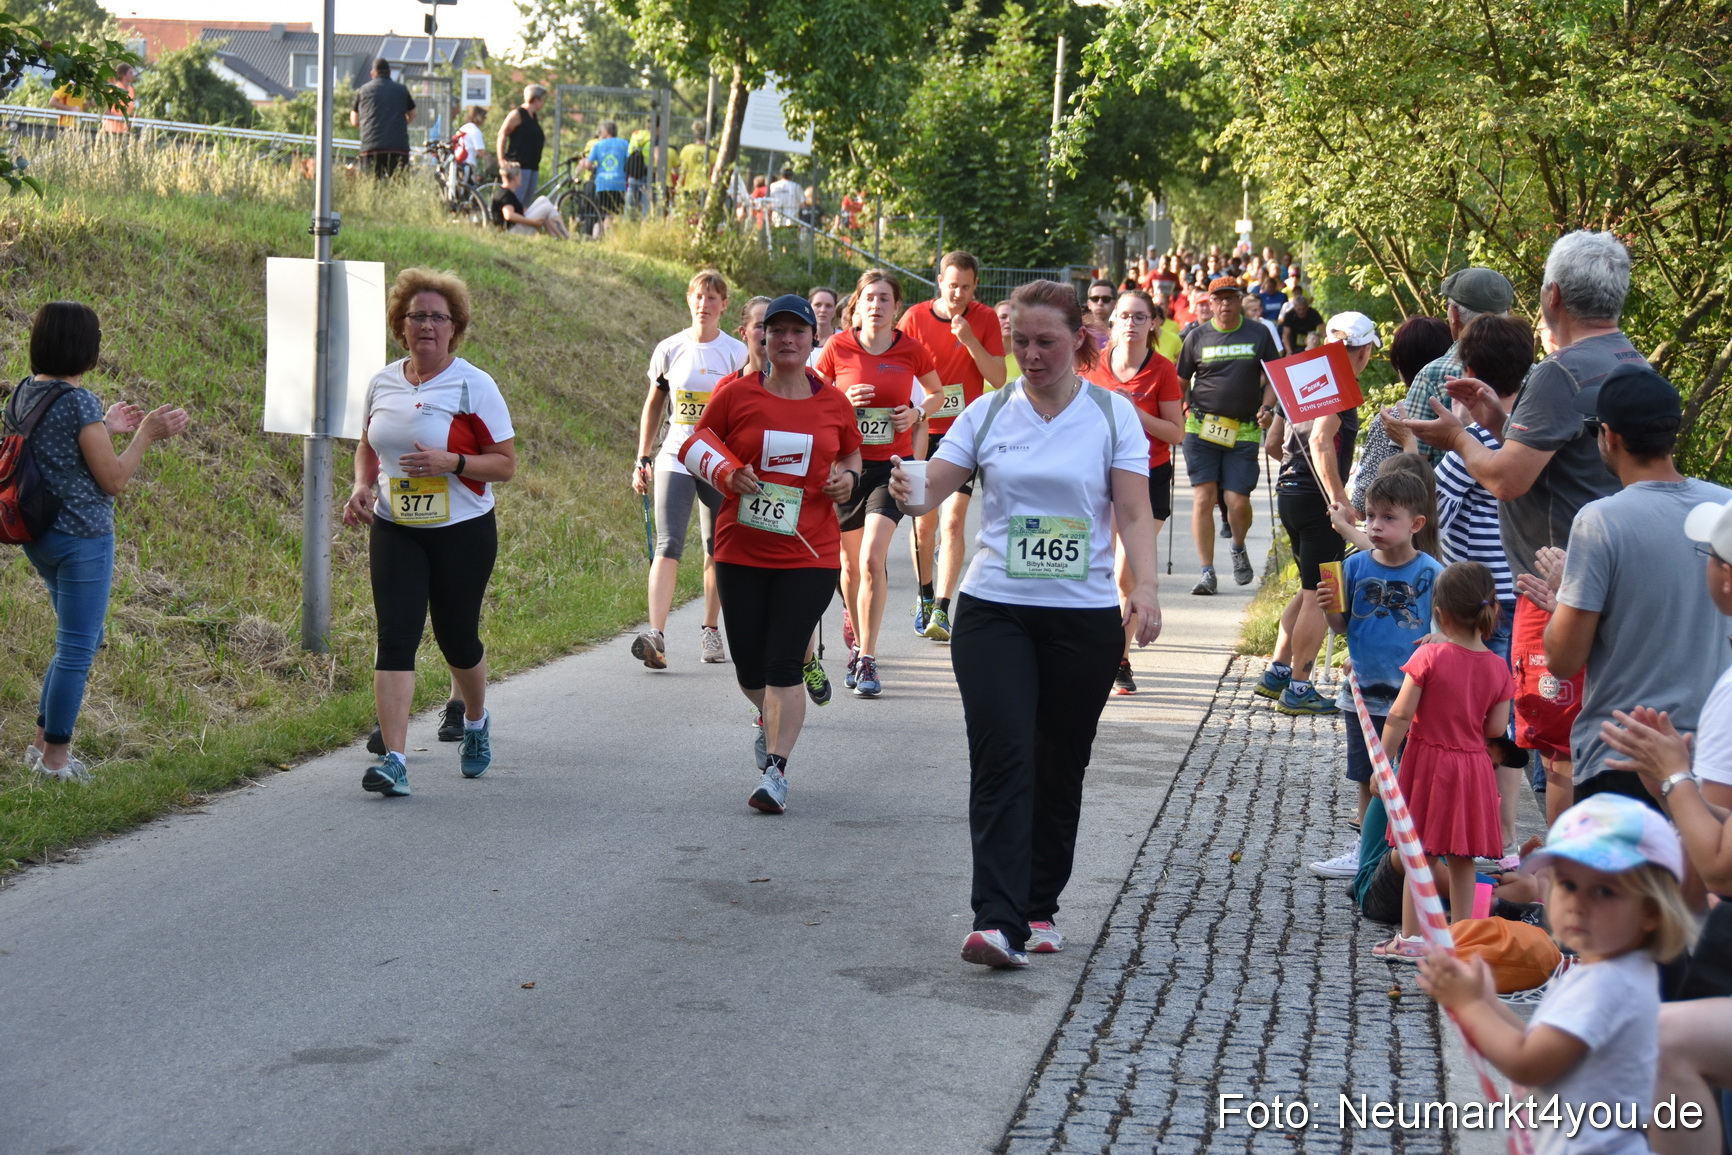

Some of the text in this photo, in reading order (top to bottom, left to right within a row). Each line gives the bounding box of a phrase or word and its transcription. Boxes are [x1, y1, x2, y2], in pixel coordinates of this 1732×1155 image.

[1202, 343, 1256, 359] BOCK
[680, 403, 705, 416] 237
[1299, 397, 1342, 412] DEHN protects.
[860, 421, 888, 434] 027
[1209, 424, 1229, 438] 311
[777, 455, 794, 463] DEHN
[400, 494, 434, 512] 377
[749, 497, 786, 519] 476
[1017, 537, 1079, 562] 1465
[1026, 560, 1069, 569] Bibyk Natalja
